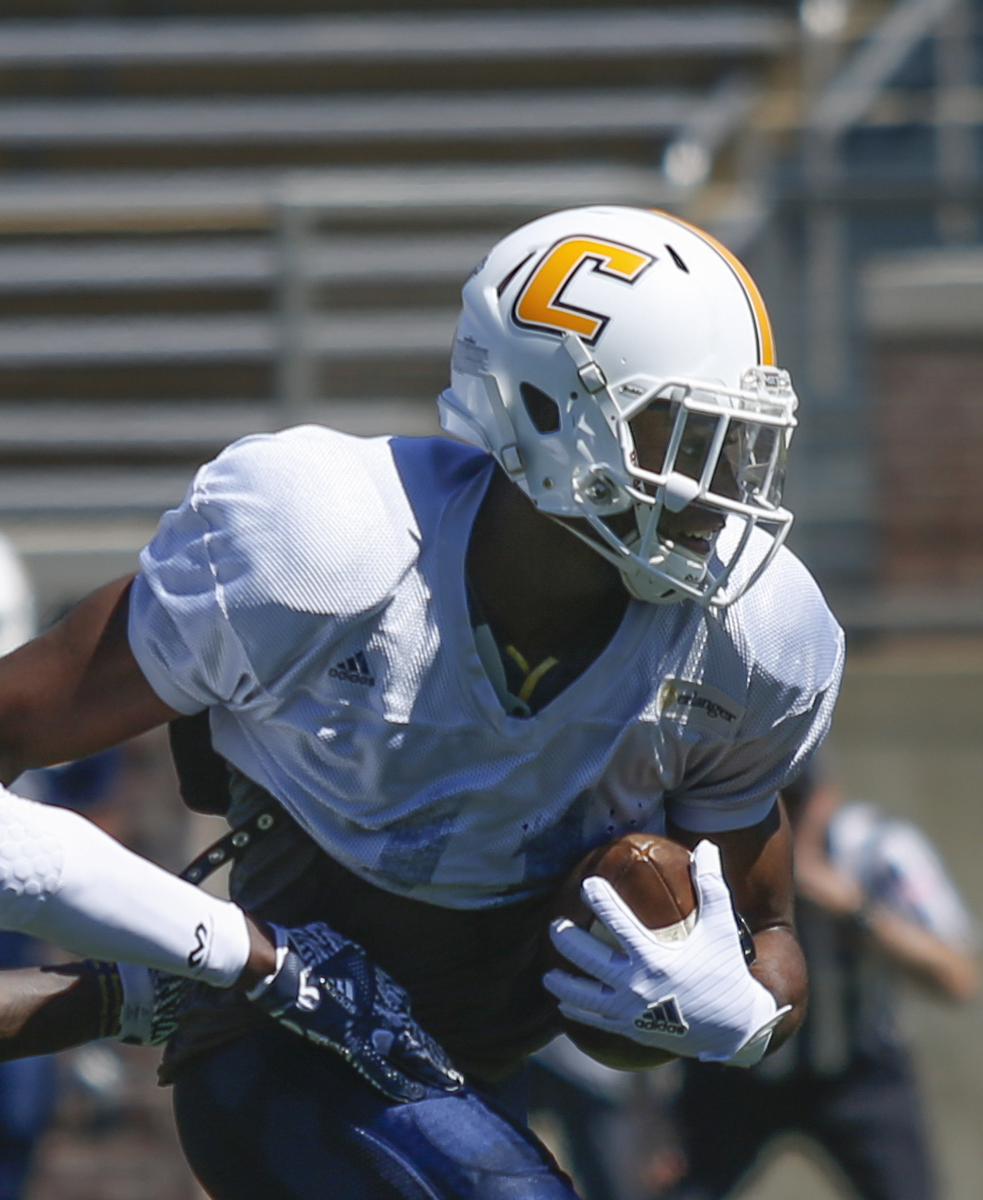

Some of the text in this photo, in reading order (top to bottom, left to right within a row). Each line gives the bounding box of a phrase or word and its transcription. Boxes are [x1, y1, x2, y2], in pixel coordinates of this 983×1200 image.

[511, 234, 659, 346] C
[329, 667, 375, 687] adidas
[634, 1019, 685, 1035] adidas
